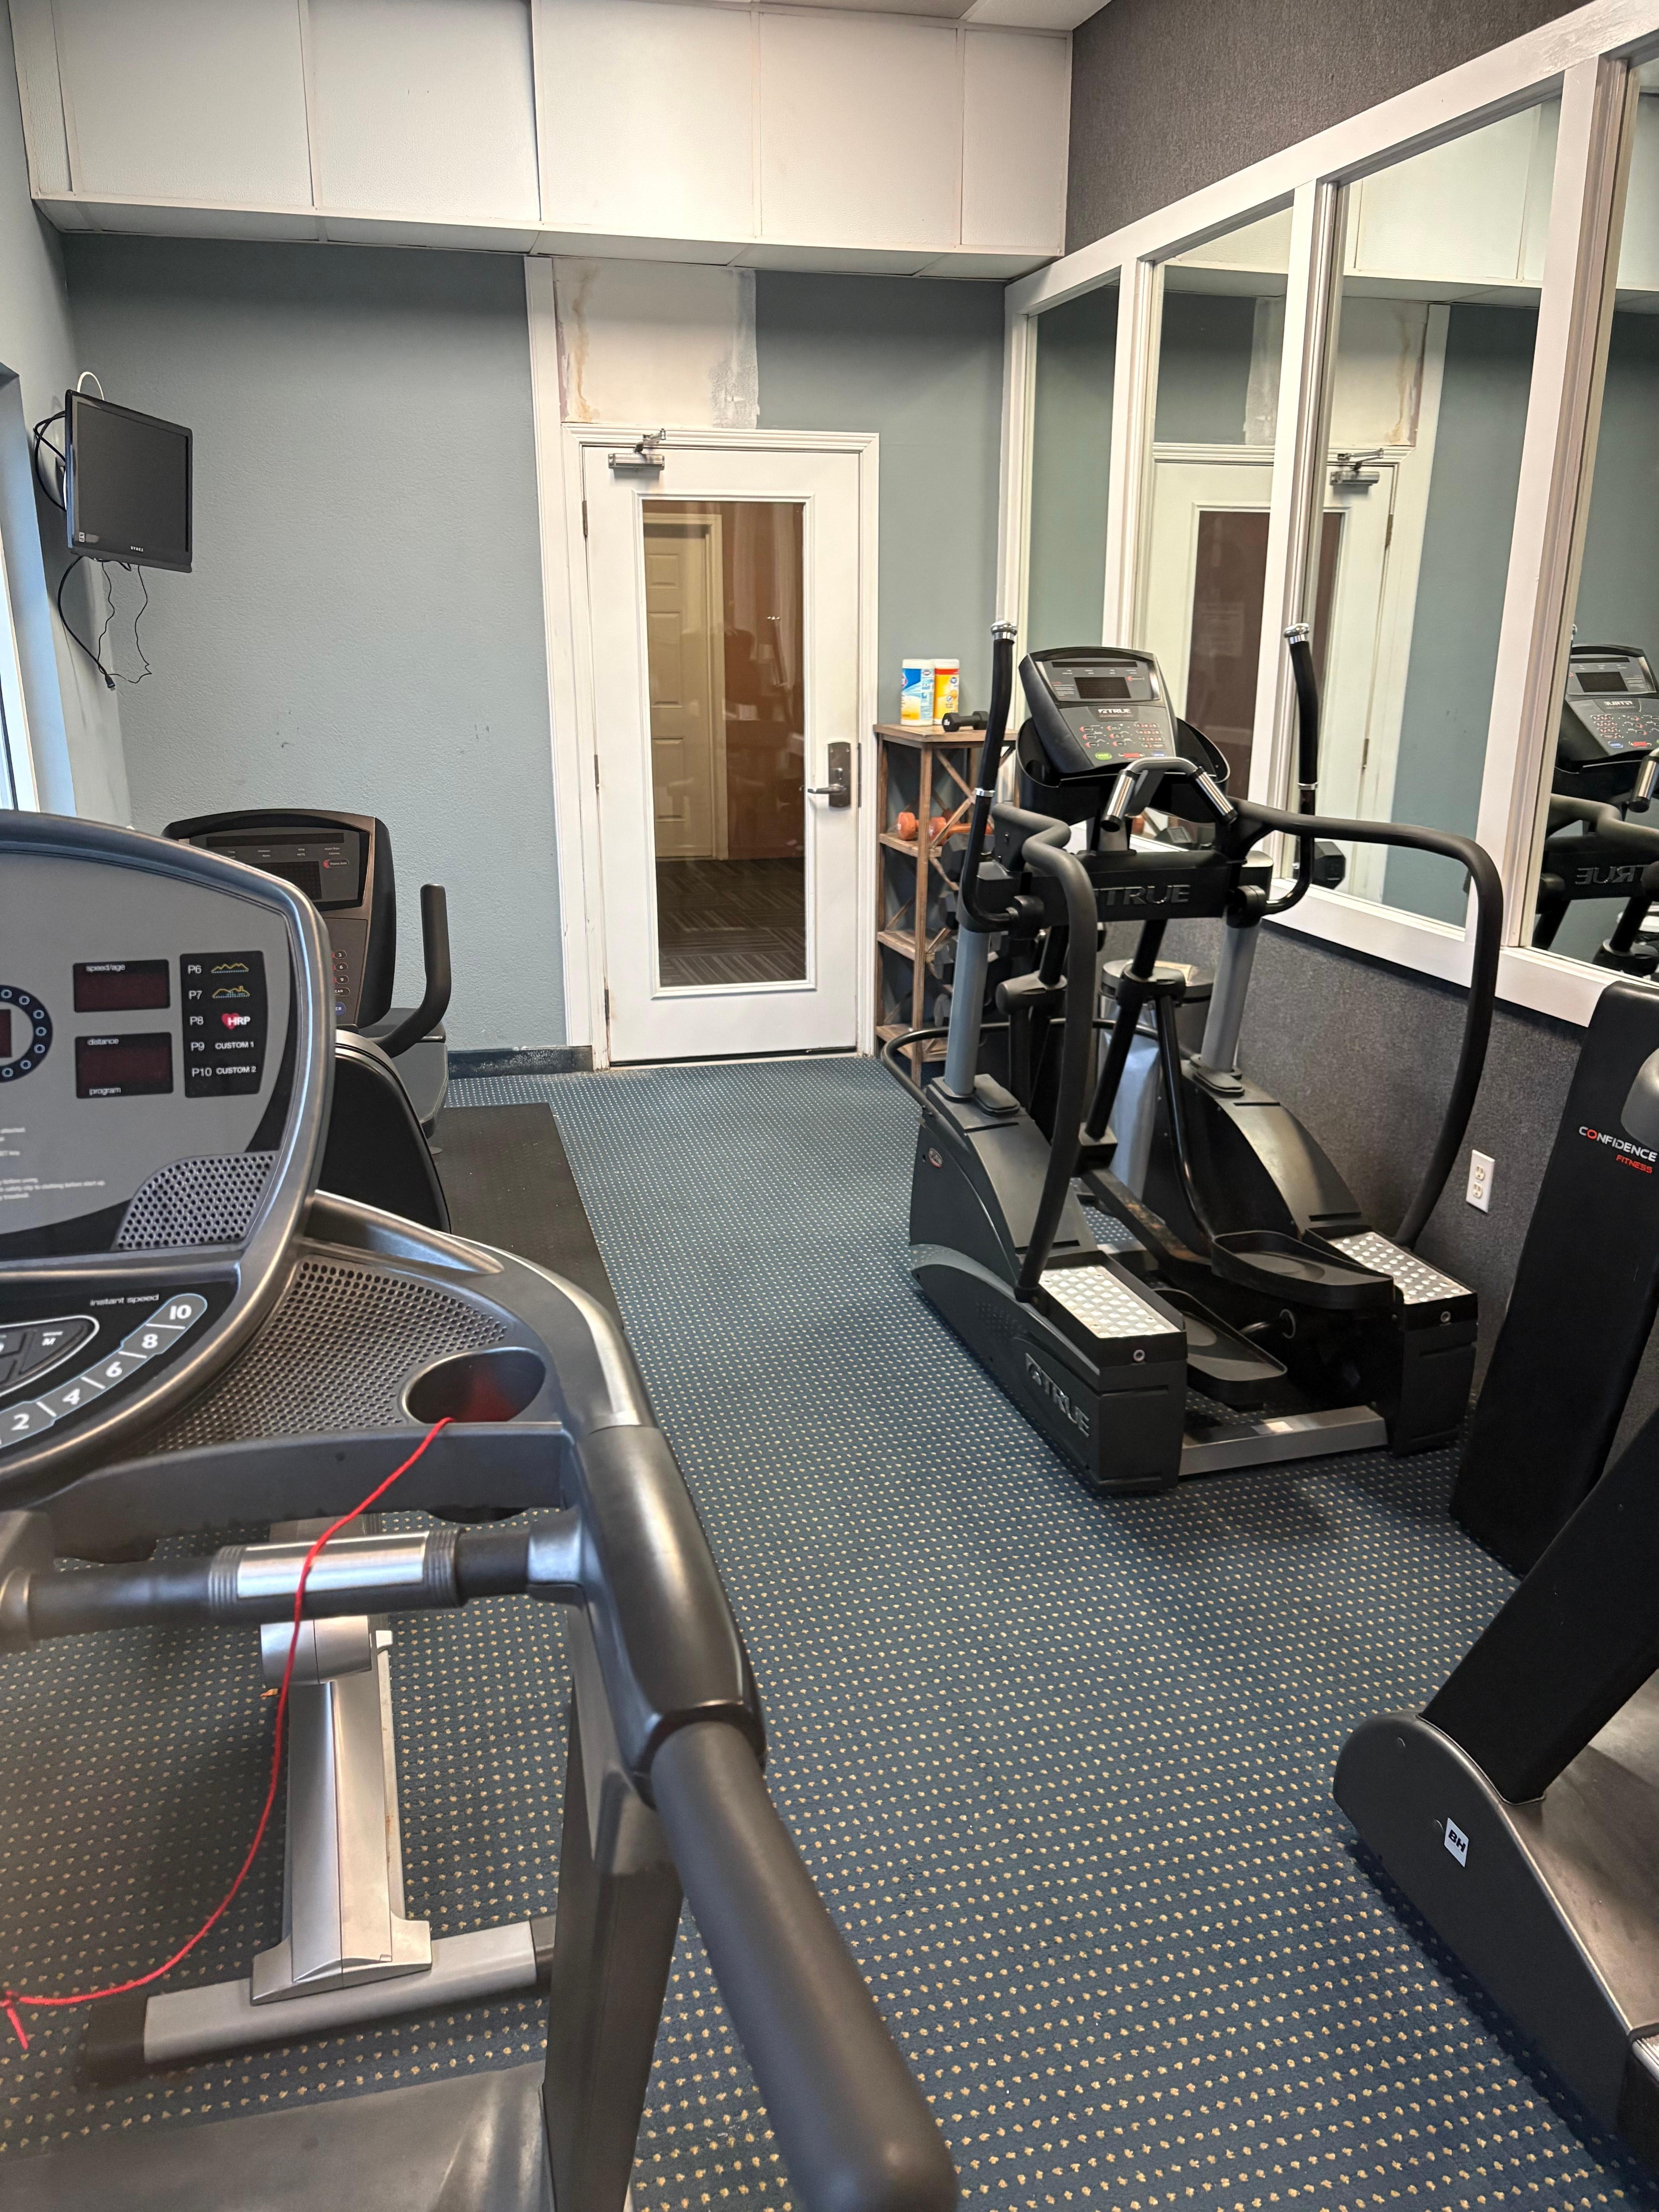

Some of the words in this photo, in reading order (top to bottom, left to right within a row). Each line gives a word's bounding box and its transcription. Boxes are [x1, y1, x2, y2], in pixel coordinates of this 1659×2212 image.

[1099, 884, 1191, 905] TRUE
[86, 963, 125, 972] speed/age
[188, 965, 202, 974] P6
[189, 990, 203, 1000] P7
[189, 1016, 204, 1025] P8
[228, 1016, 251, 1026] HRP
[191, 1042, 205, 1051] P9
[191, 1067, 212, 1077] P10
[216, 1066, 250, 1075] CUSTOM
[89, 1087, 121, 1096] program
[1579, 1126, 1657, 1162] CONFIDENCE
[1616, 1154, 1652, 1174] FITNESS
[89, 1297, 124, 1307] instant
[126, 1293, 159, 1304] speed
[169, 1305, 192, 1320] 10
[141, 1334, 158, 1349] 8
[106, 1362, 122, 1377] 6
[62, 1388, 81, 1405] 4
[1040, 1368, 1089, 1438] TRUE
[10, 1413, 29, 1431] 2
[1448, 1829, 1466, 1853] BH
